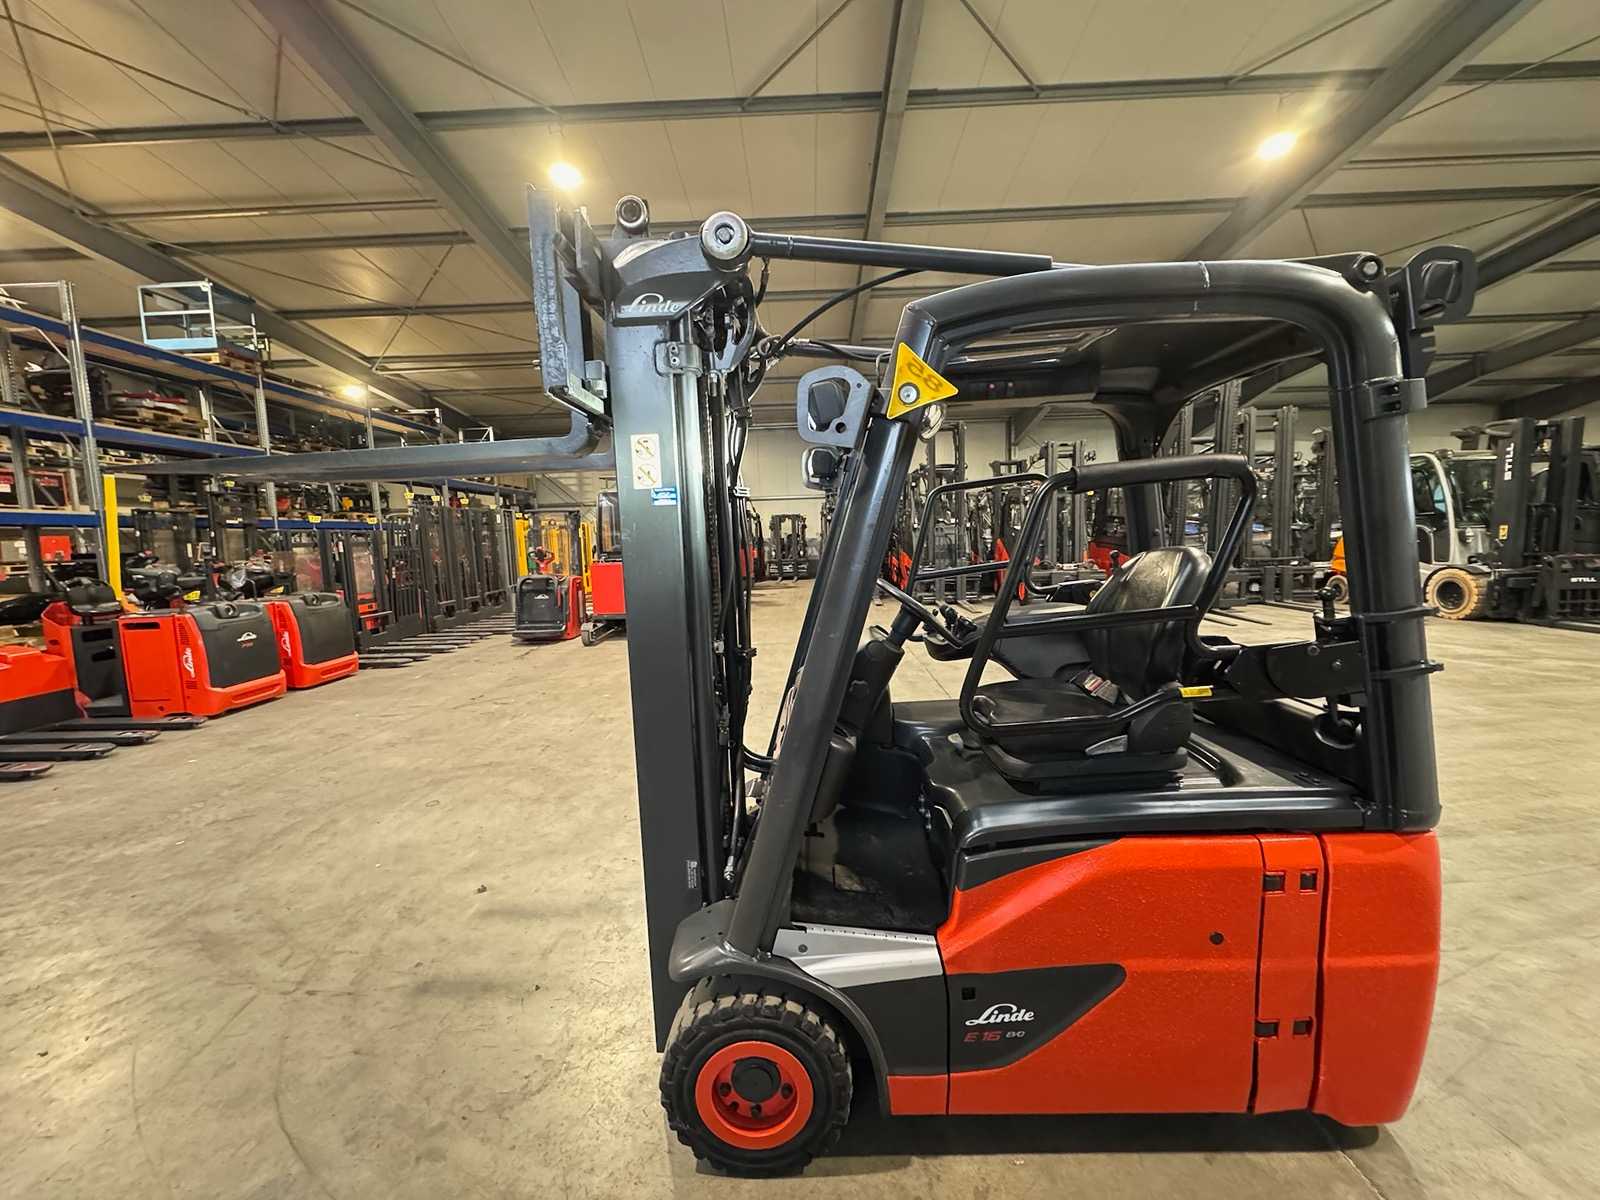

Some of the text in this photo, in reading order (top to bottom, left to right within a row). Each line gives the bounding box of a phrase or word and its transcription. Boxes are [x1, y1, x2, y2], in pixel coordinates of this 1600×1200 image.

[621, 293, 681, 313] Linde
[1503, 442, 1515, 481] STILL
[965, 1003, 1035, 1026] Linde
